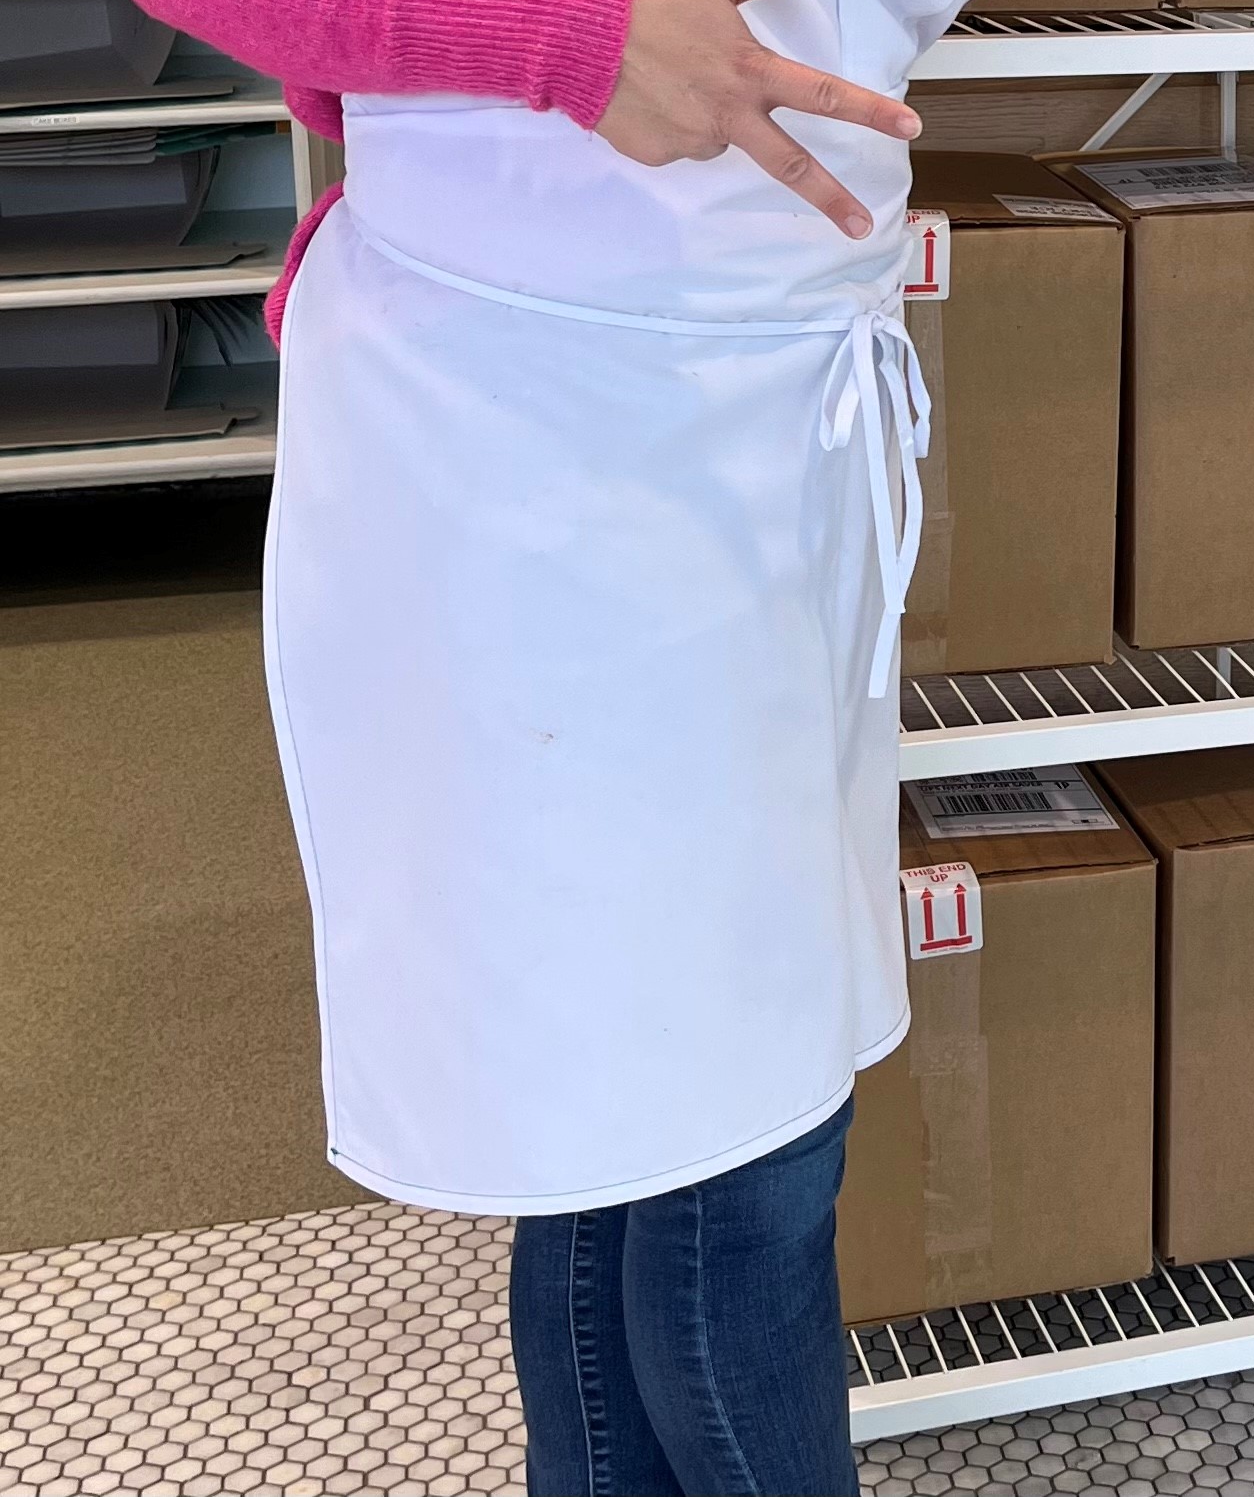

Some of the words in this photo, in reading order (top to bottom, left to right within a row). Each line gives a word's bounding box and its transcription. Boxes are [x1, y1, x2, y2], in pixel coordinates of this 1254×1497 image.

[905, 867, 936, 878] THIS
[938, 863, 967, 873] END
[929, 873, 949, 883] UP
